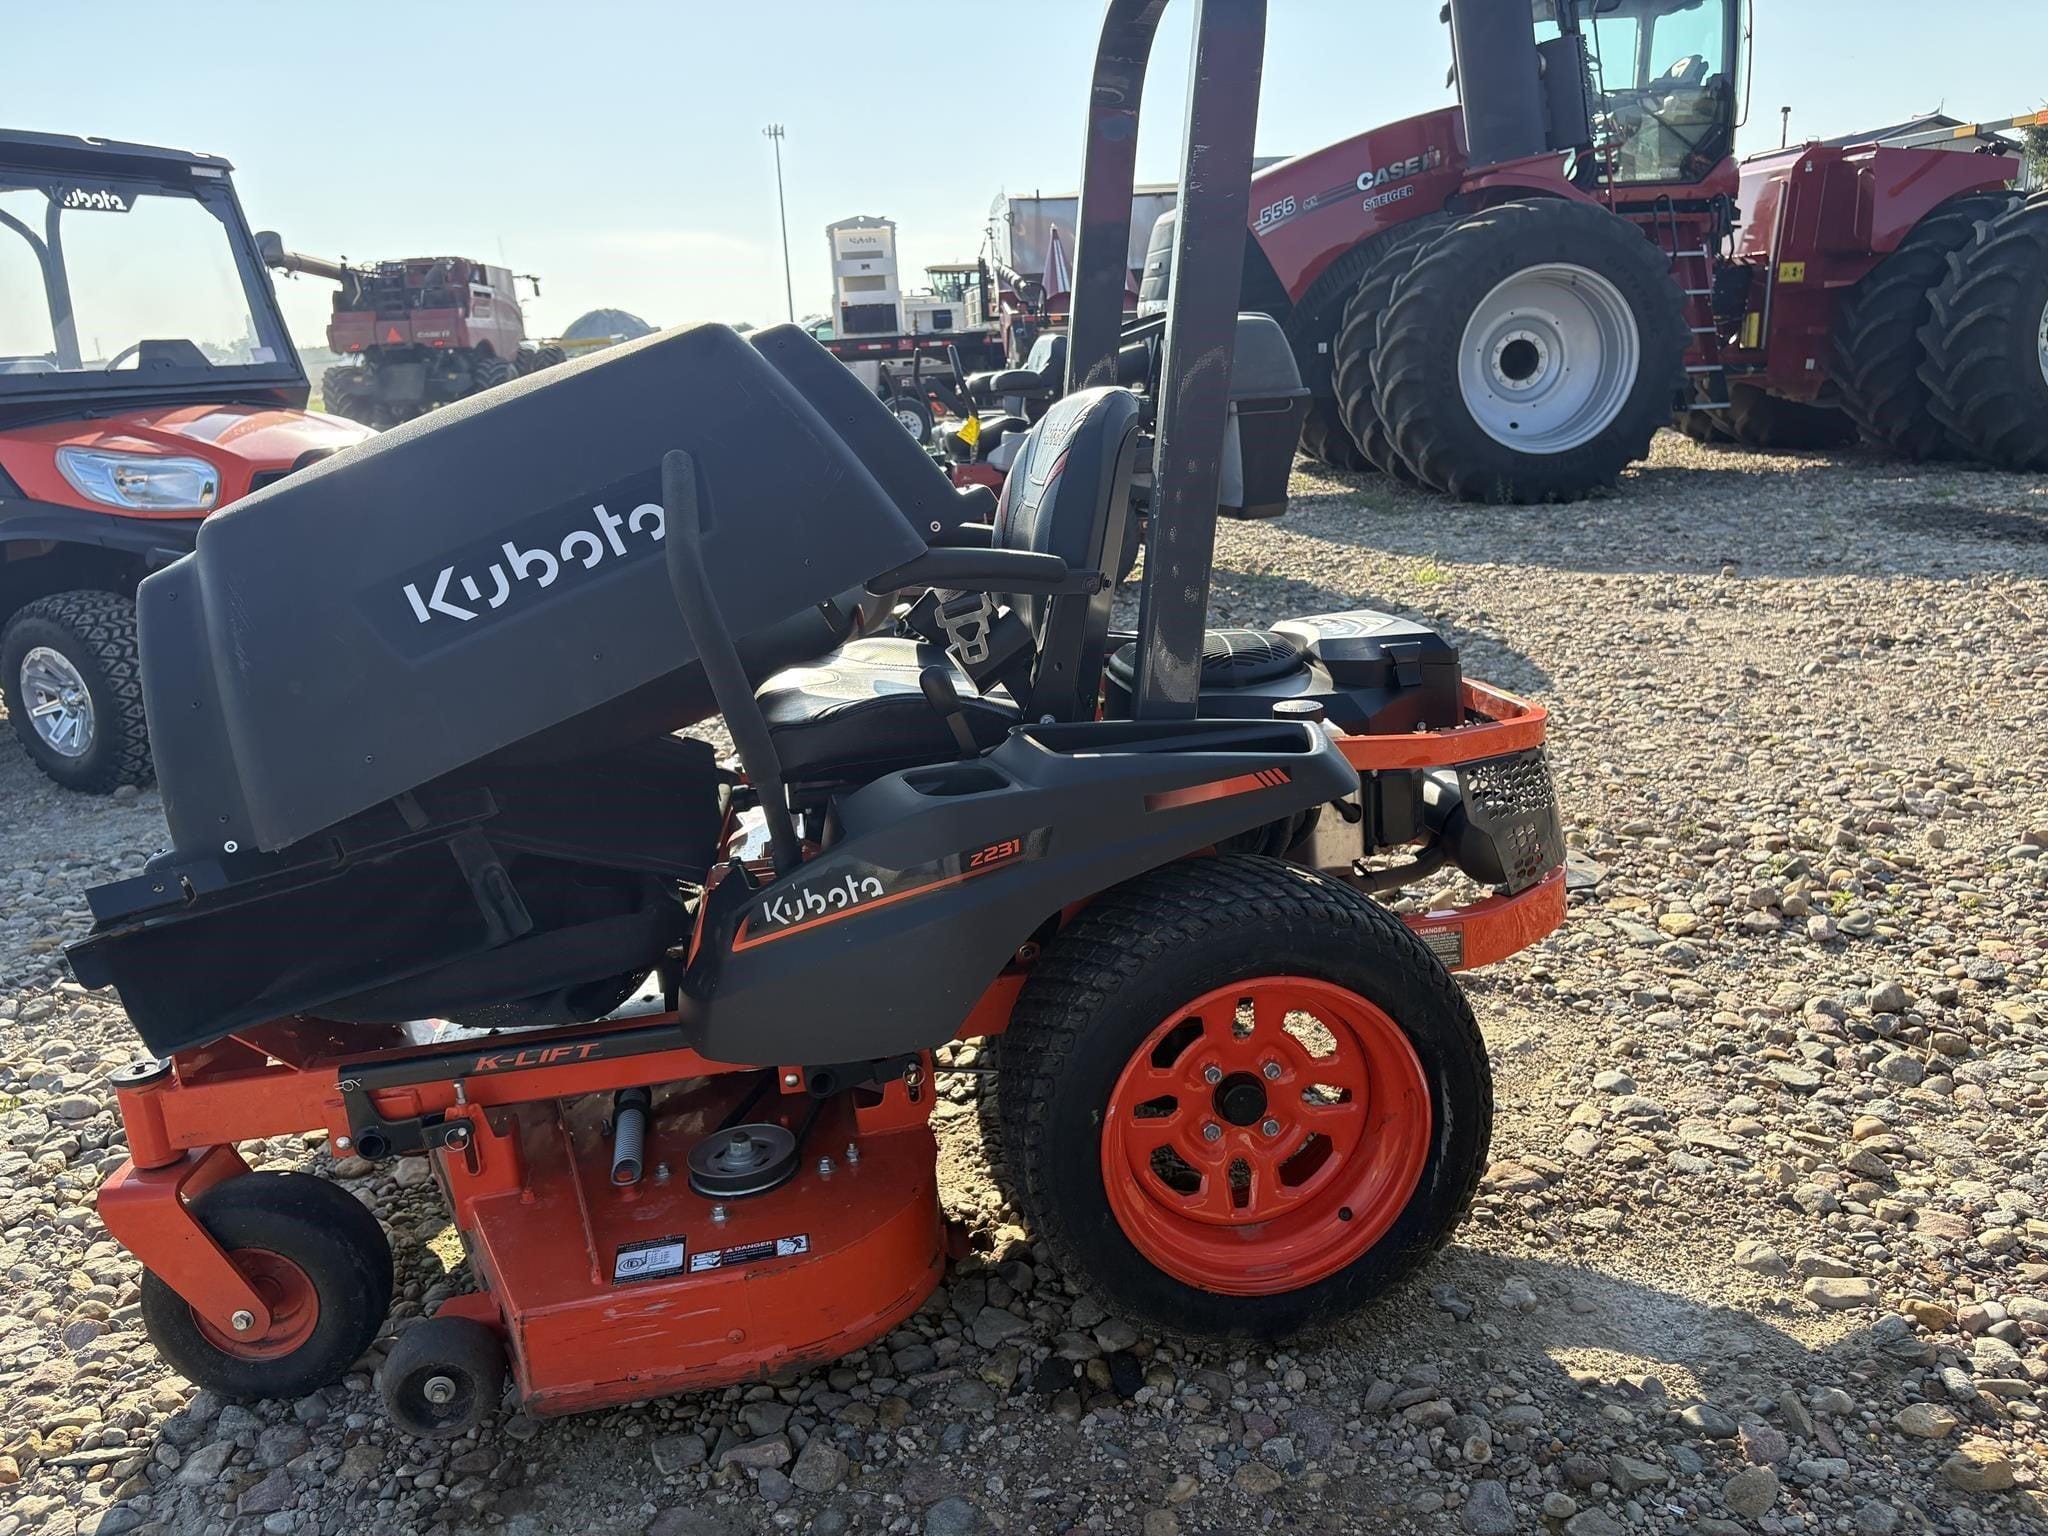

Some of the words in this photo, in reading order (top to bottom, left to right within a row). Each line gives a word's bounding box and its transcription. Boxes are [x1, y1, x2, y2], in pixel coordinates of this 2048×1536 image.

[1356, 156, 1420, 191] CASE
[1260, 195, 1297, 226] 555
[1363, 185, 1413, 212] STEIGER
[403, 503, 665, 623] Kubota
[763, 874, 885, 925] Kubota
[1420, 926, 1447, 935] DANGER
[475, 1043, 600, 1072] K-LIFT
[734, 1240, 773, 1252] DANGER
